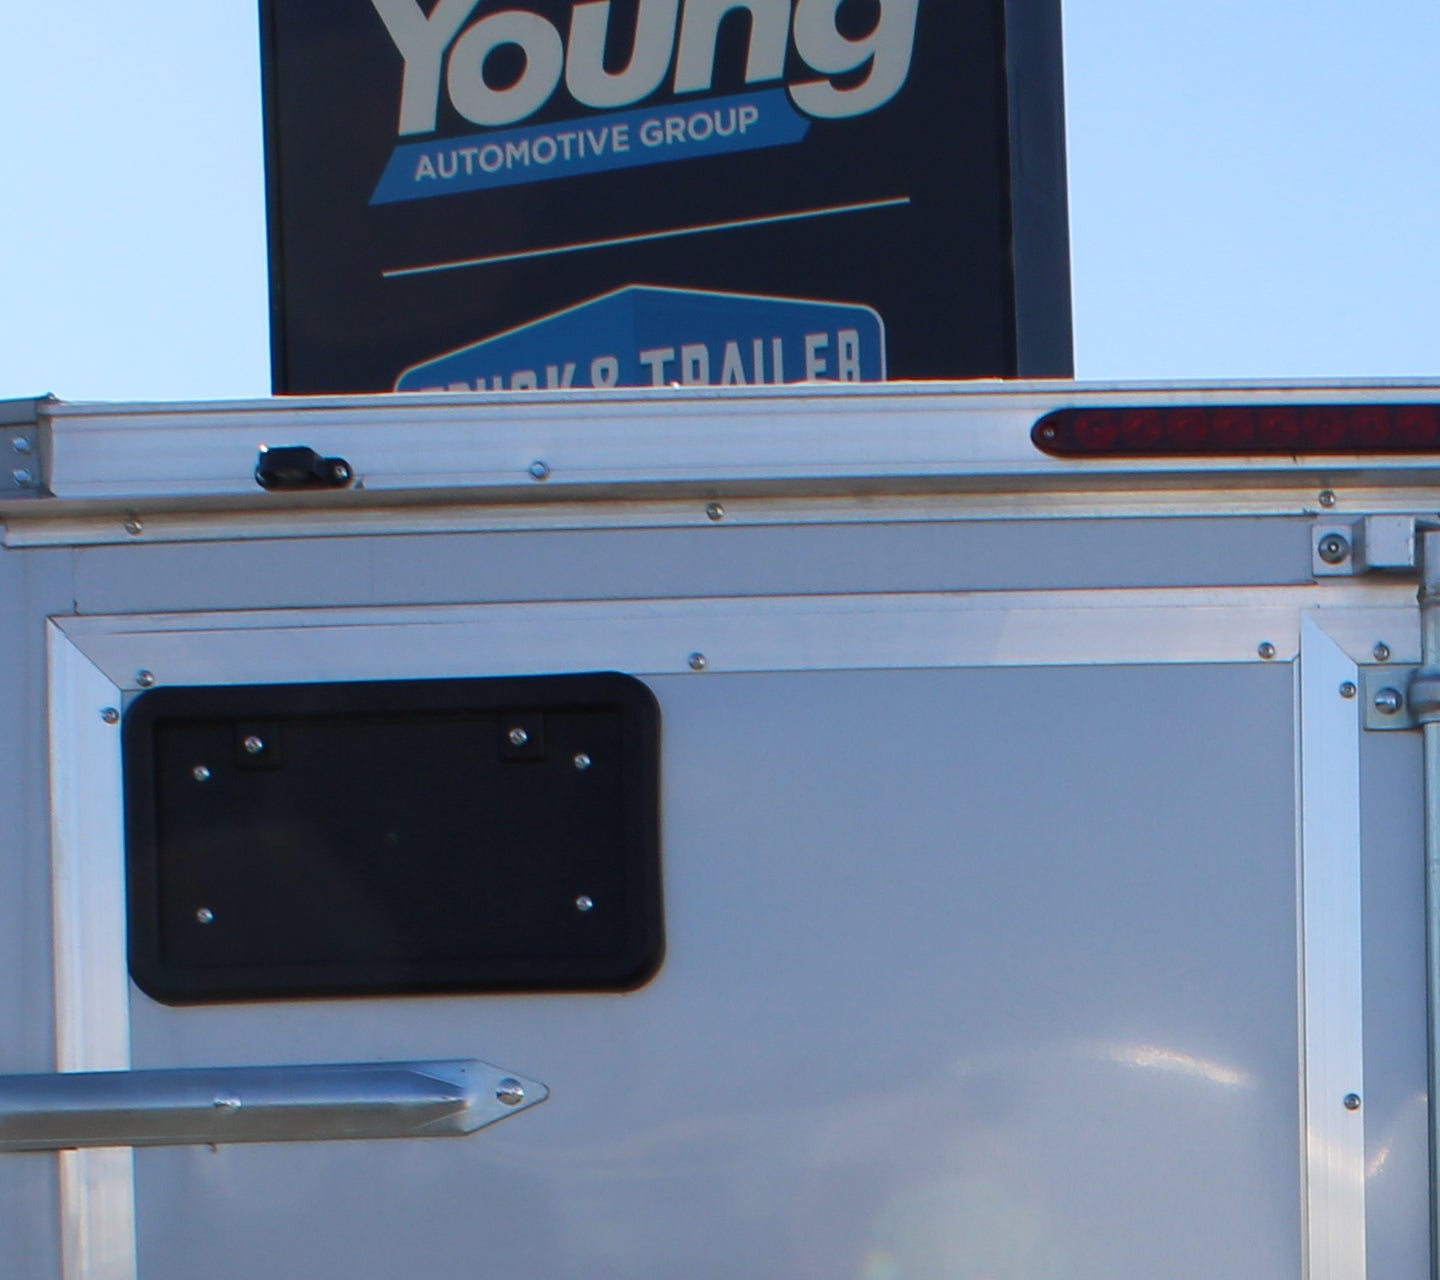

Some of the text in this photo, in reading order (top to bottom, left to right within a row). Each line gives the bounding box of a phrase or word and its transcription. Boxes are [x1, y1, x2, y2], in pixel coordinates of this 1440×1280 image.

[372, 0, 917, 137] Young
[414, 106, 760, 182] AUTOMOTIVE GROUP
